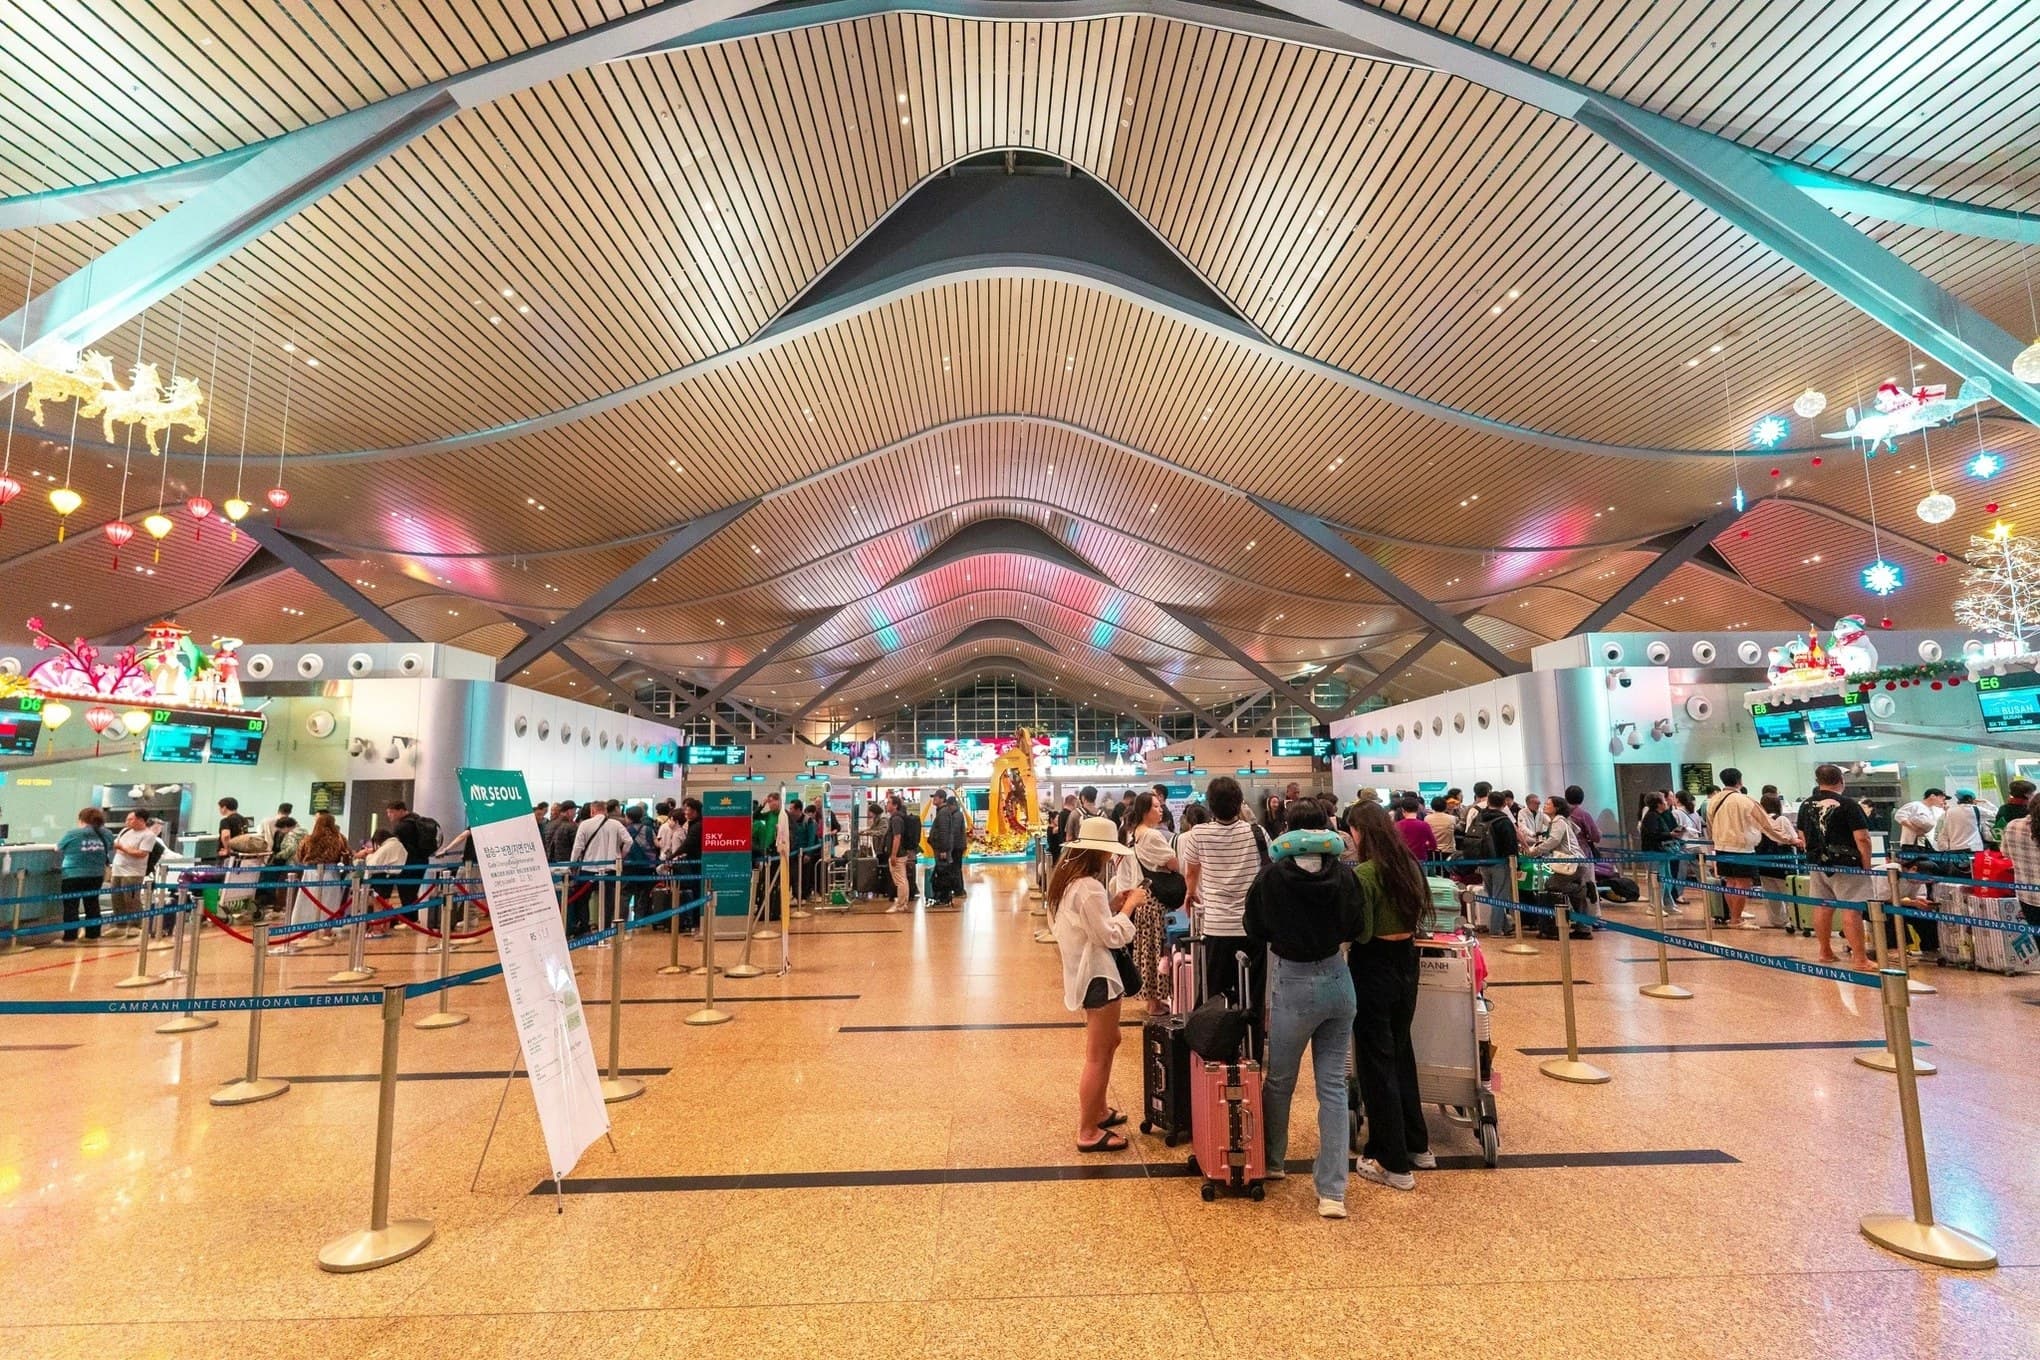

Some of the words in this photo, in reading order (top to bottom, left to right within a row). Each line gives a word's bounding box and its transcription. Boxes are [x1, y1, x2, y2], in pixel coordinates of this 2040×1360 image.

[1980, 677, 2000, 690] E6
[20, 697, 41, 711] D6
[1844, 694, 1858, 704] E7
[1754, 705, 1767, 714] E8
[154, 710, 171, 722] D7
[248, 720, 263, 731] D8
[488, 786, 522, 801] SEOUL
[705, 839, 746, 847] PRIORITY
[1906, 909, 1955, 921] CAMRANH
[274, 922, 332, 934] INTERNATIONAL
[335, 917, 366, 926] TERMINAL
[1663, 935, 1706, 951] CAMRANH
[1709, 944, 1788, 969] INTERNATIONAL
[1795, 963, 1855, 982] TERMINAL
[108, 1001, 180, 1012] CAMRANH
[187, 997, 299, 1009] INTERNATIONAL
[309, 994, 377, 1006] TERMINAL
